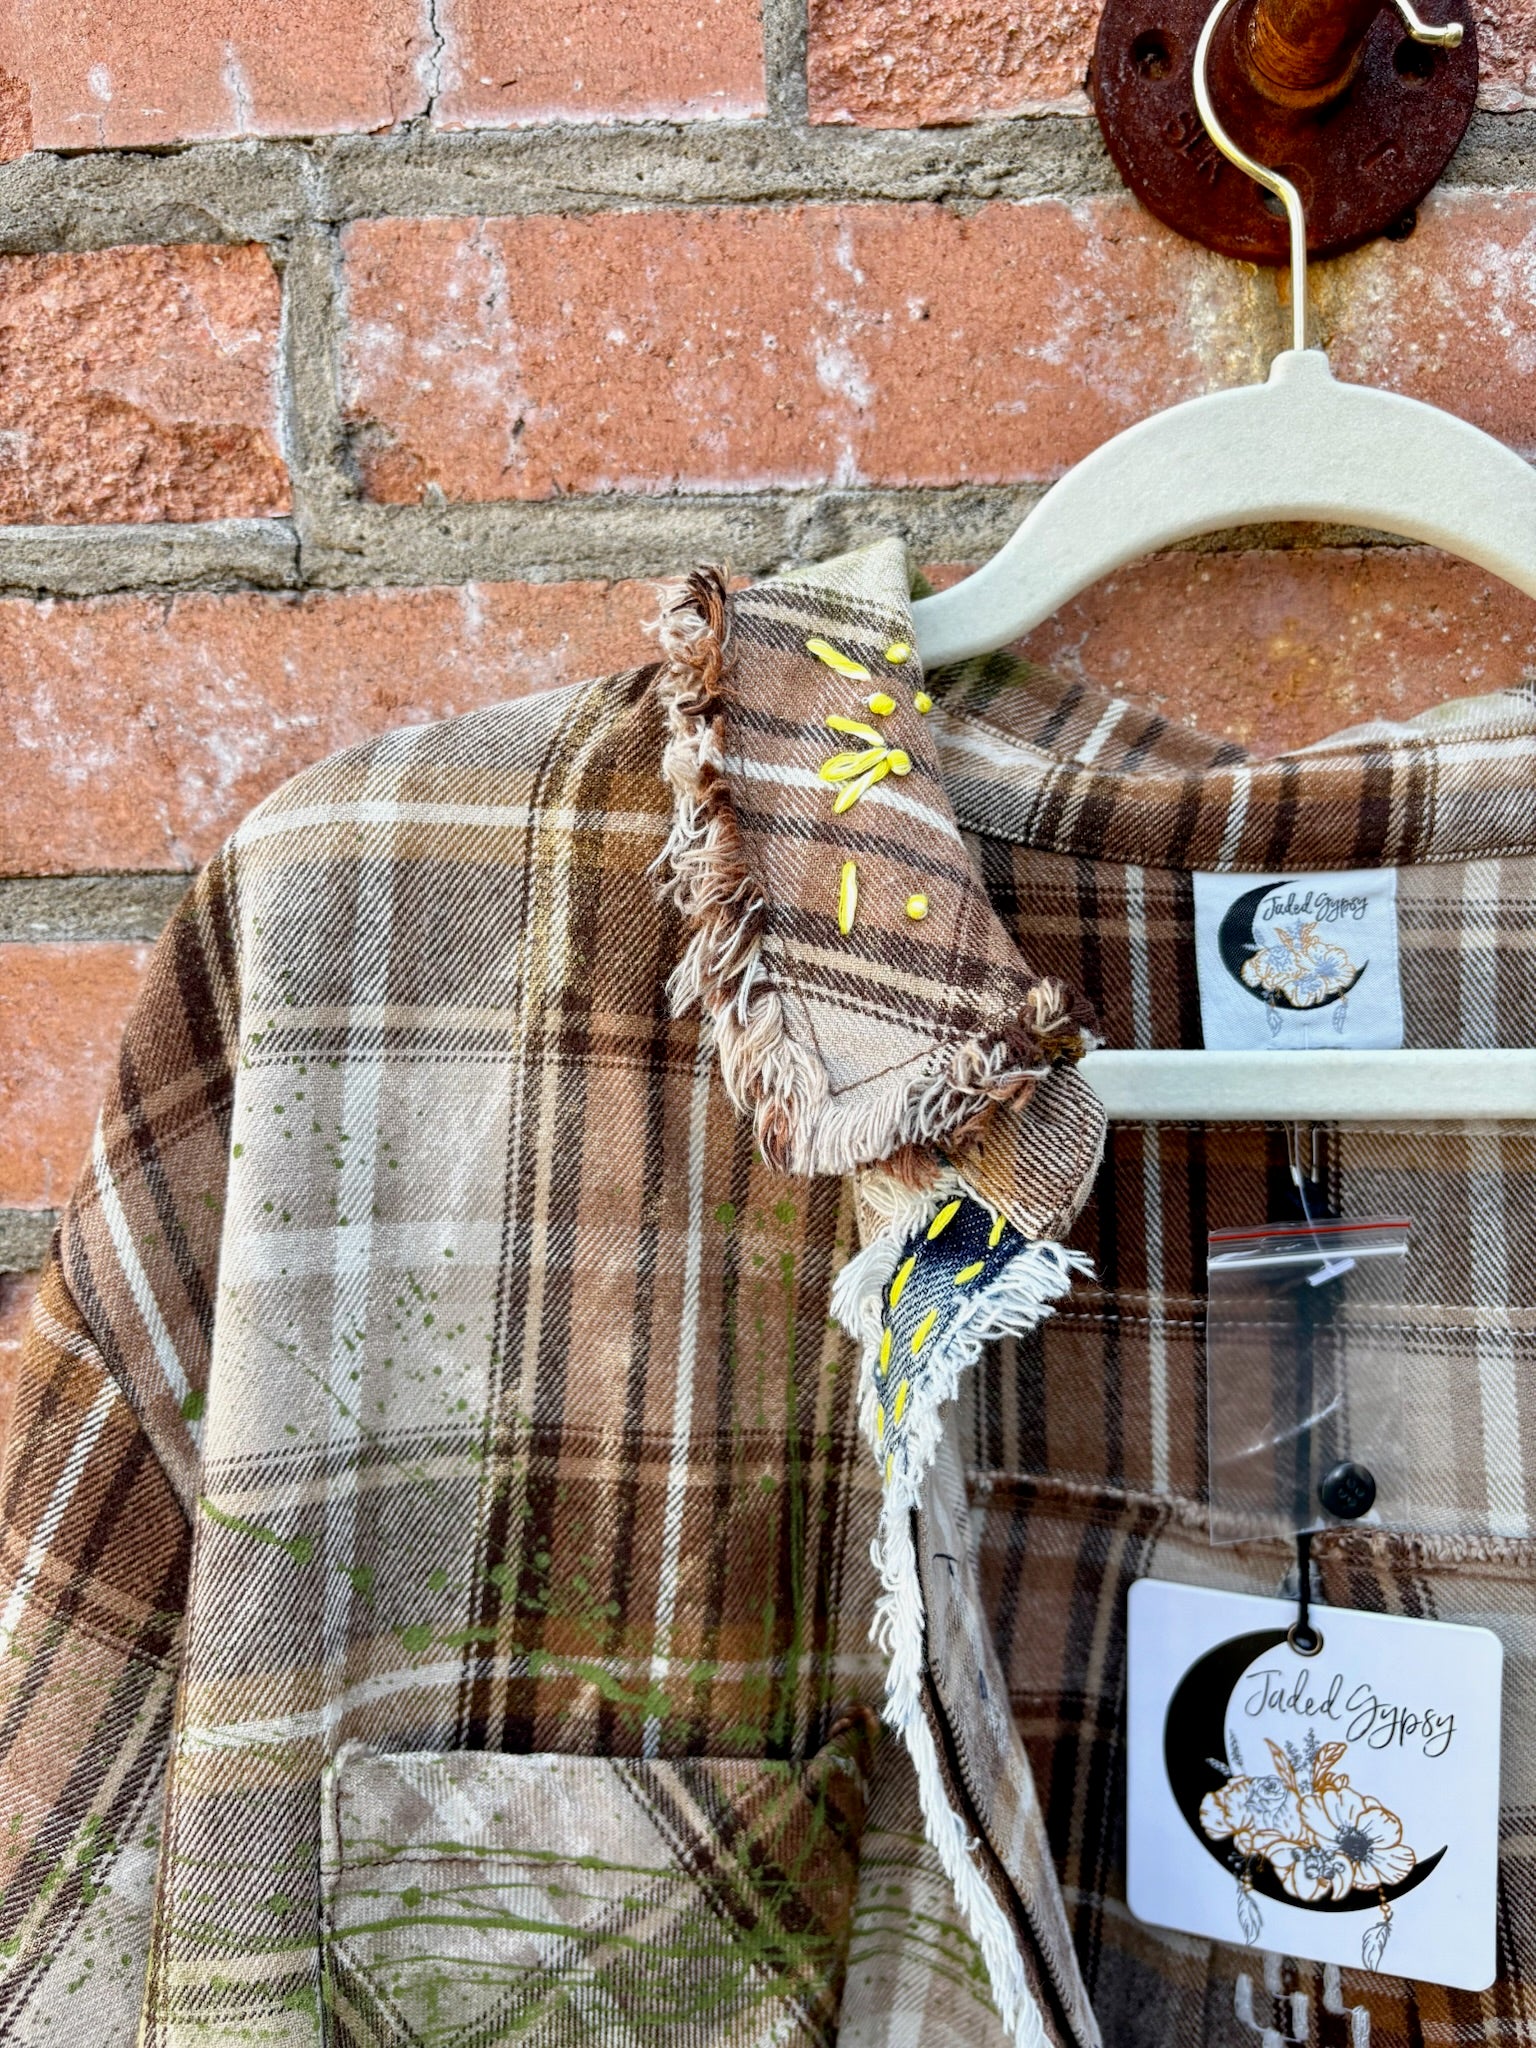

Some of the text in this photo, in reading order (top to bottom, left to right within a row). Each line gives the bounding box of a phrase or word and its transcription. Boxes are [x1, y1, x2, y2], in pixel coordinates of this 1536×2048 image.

[1262, 891, 1369, 923] Jaded Gypsy
[1244, 1668, 1457, 1758] Jaded Gypsy
